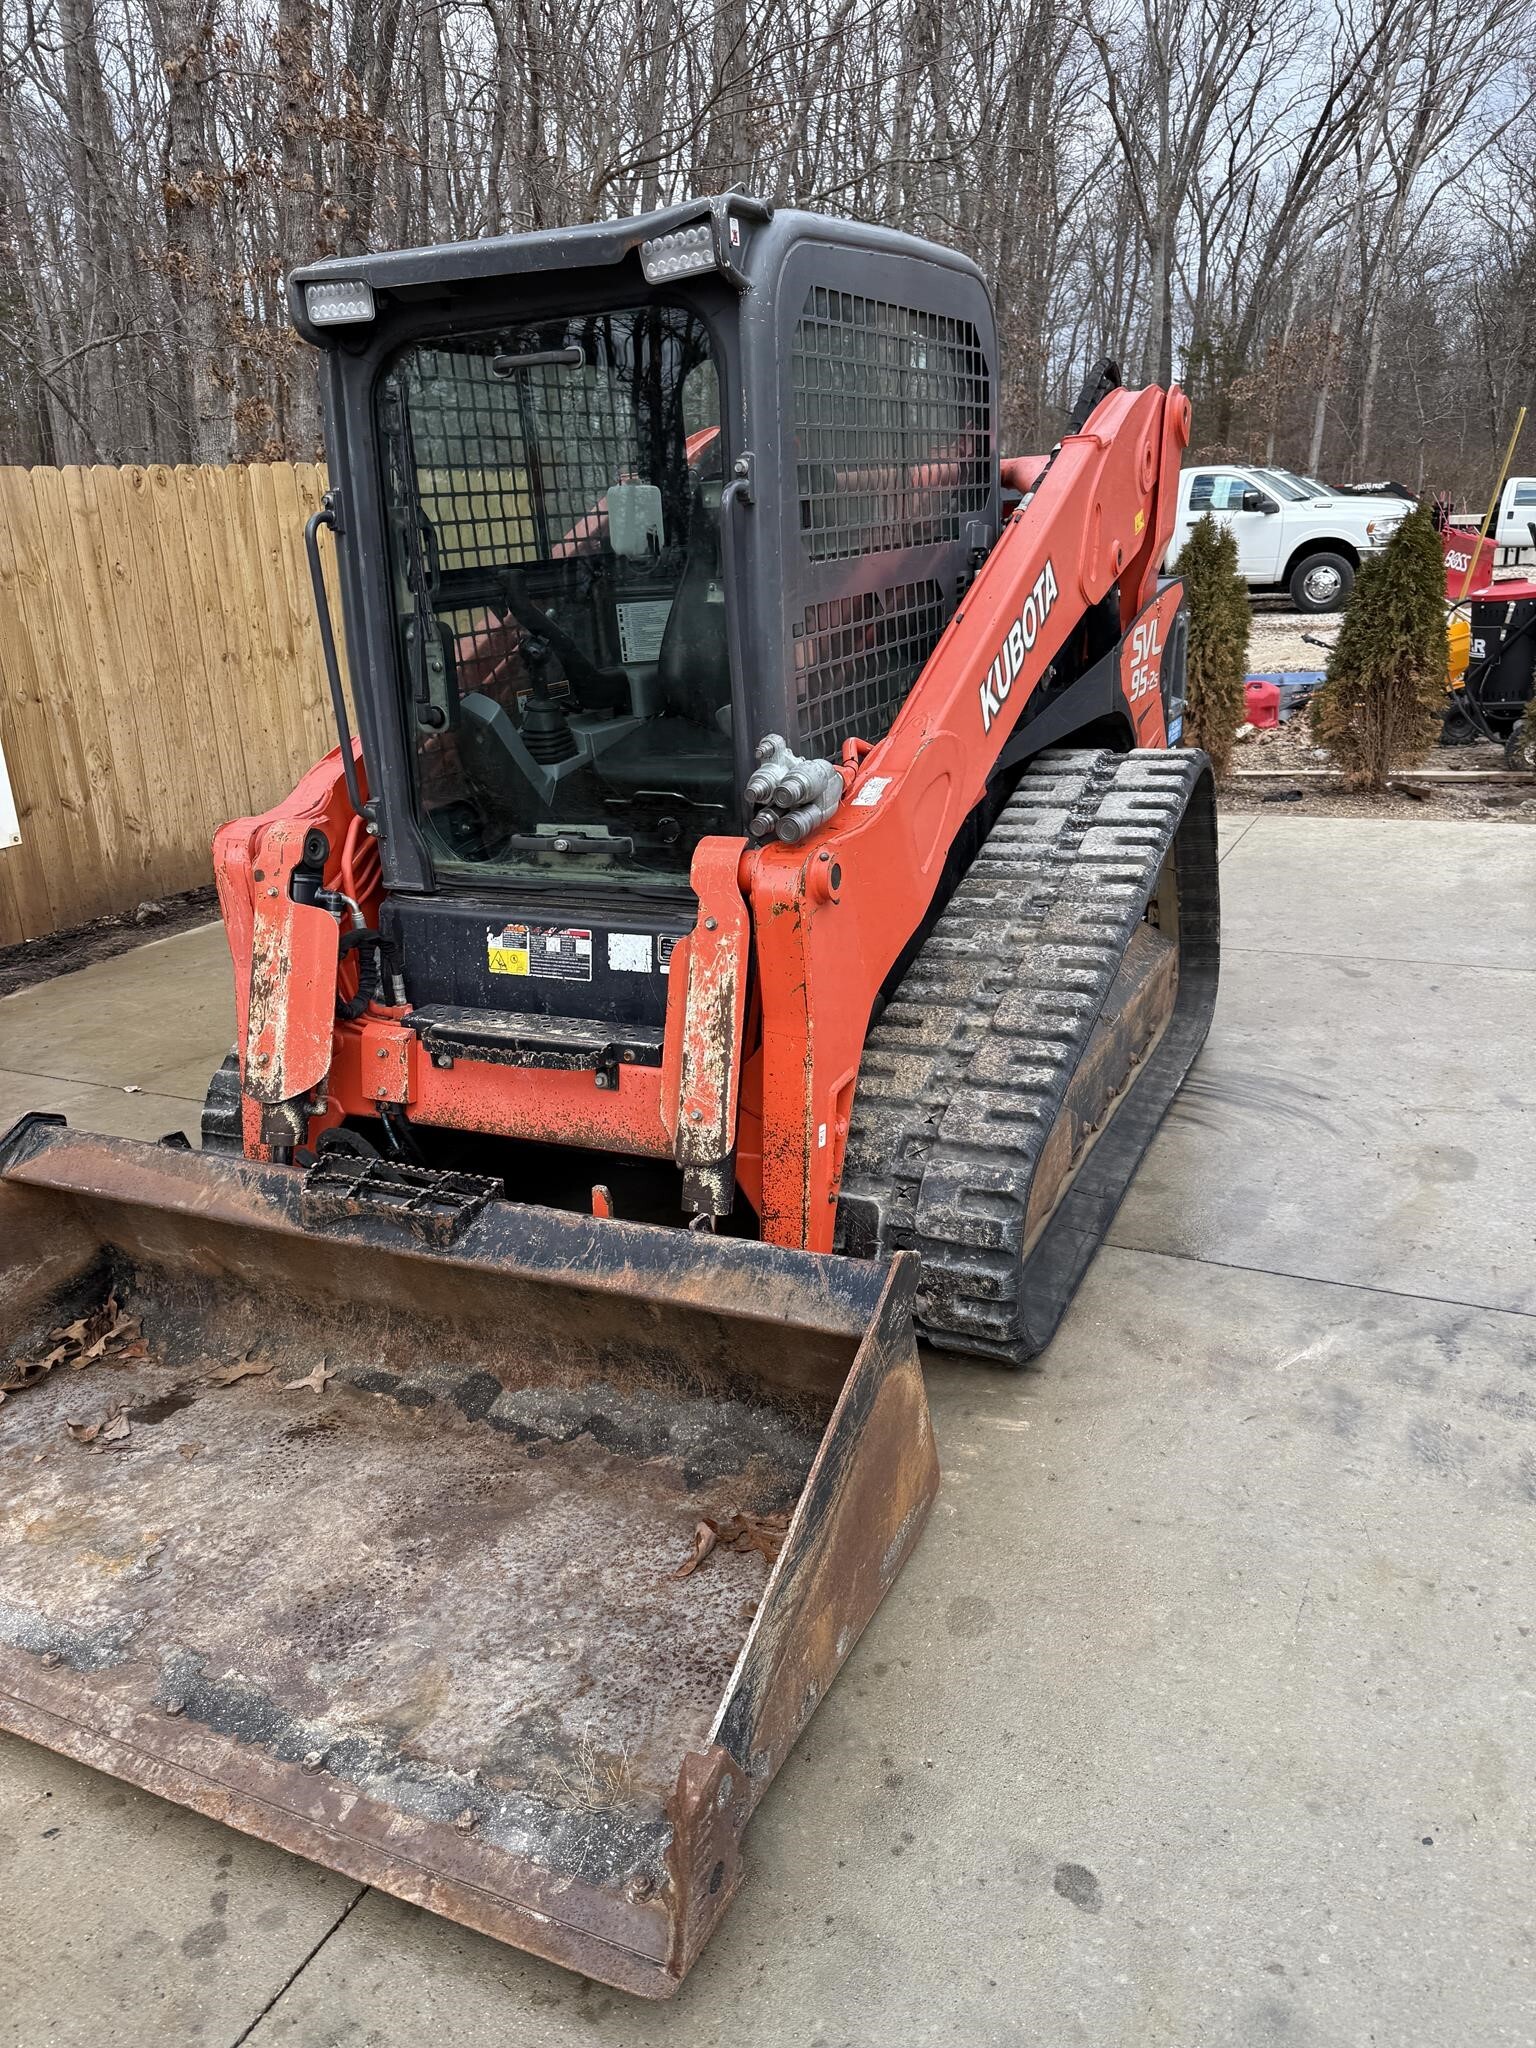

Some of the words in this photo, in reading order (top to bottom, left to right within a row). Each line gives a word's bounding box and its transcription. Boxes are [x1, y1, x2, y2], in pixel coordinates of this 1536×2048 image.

[1444, 549, 1472, 572] BOSS
[978, 558, 1059, 735] KUBOTA
[1130, 618, 1162, 669] SVL
